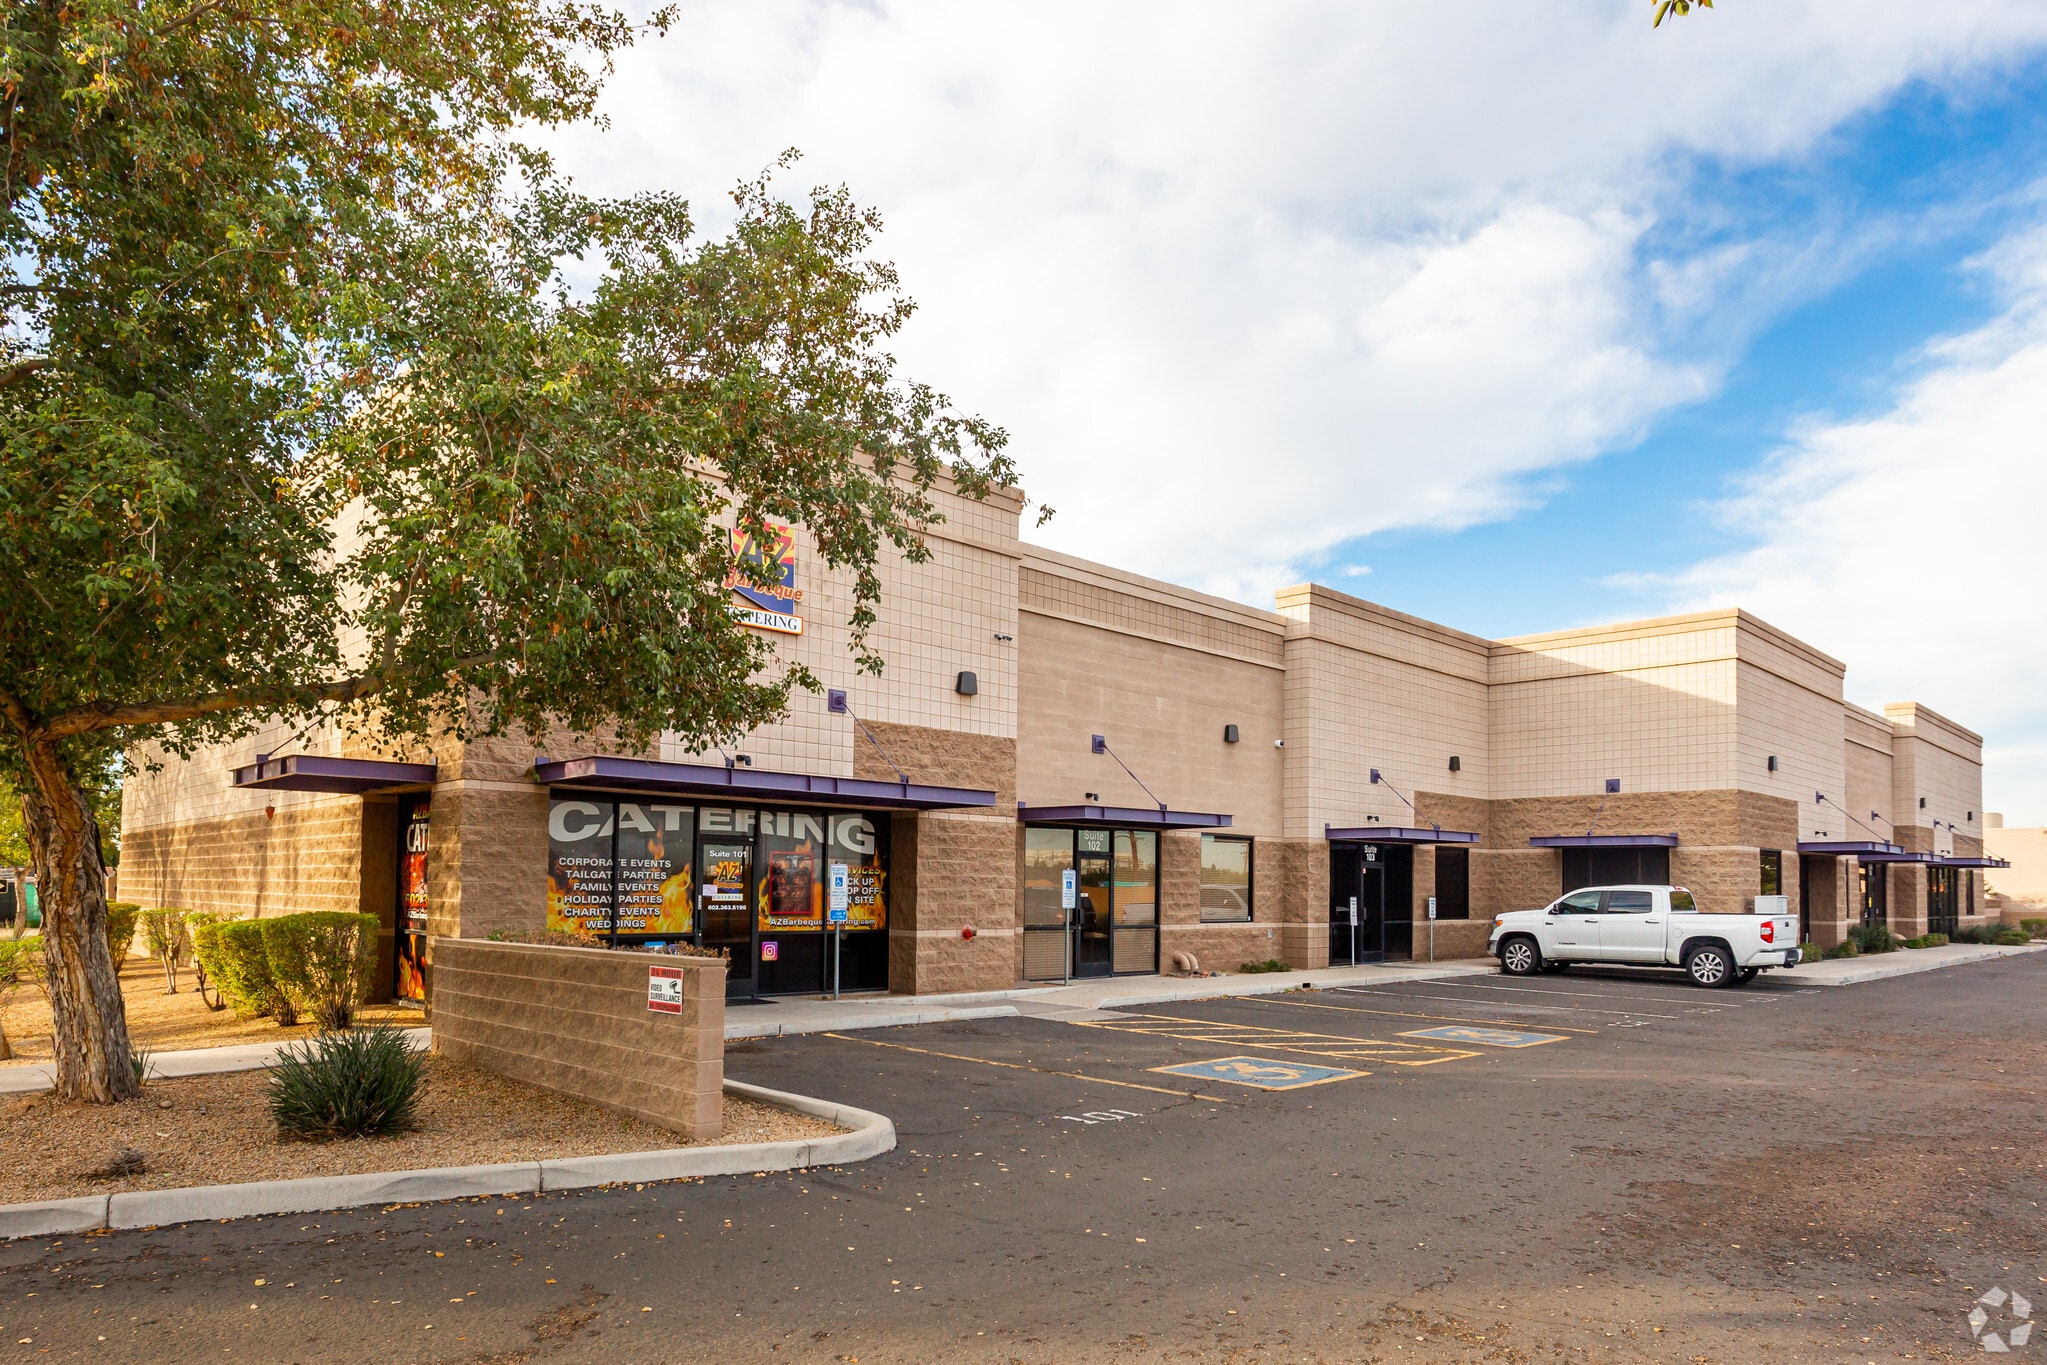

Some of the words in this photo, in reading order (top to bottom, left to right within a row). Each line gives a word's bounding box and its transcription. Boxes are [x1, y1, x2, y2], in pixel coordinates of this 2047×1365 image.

[549, 801, 875, 855] CATERING
[1084, 830, 1104, 841] Suite
[1087, 841, 1101, 851] 102
[709, 849, 730, 858] Suite
[732, 850, 747, 858] 101
[558, 857, 627, 867] CORPORAE
[630, 858, 671, 868] EVENTS
[565, 870, 620, 879] TAILGAT
[623, 871, 667, 880] PARTIES
[718, 864, 738, 881] AZ
[847, 866, 881, 875] RVICES
[847, 877, 859, 886] CK
[862, 878, 875, 886] UP
[573, 882, 613, 891] FAMILY
[618, 883, 660, 892] EVENTS
[847, 886, 859, 895] OP
[862, 887, 880, 895] OFF
[564, 895, 613, 904] HOLIDAY
[618, 895, 663, 904] PARTIES
[854, 896, 875, 904] SITE
[564, 907, 613, 916] CHARITY
[619, 907, 661, 916] EVENTS
[651, 967, 659, 977] 24
[662, 968, 681, 979] HOUR
[650, 984, 662, 992] VIDEO
[650, 992, 681, 1004] SURVEILLANCE
